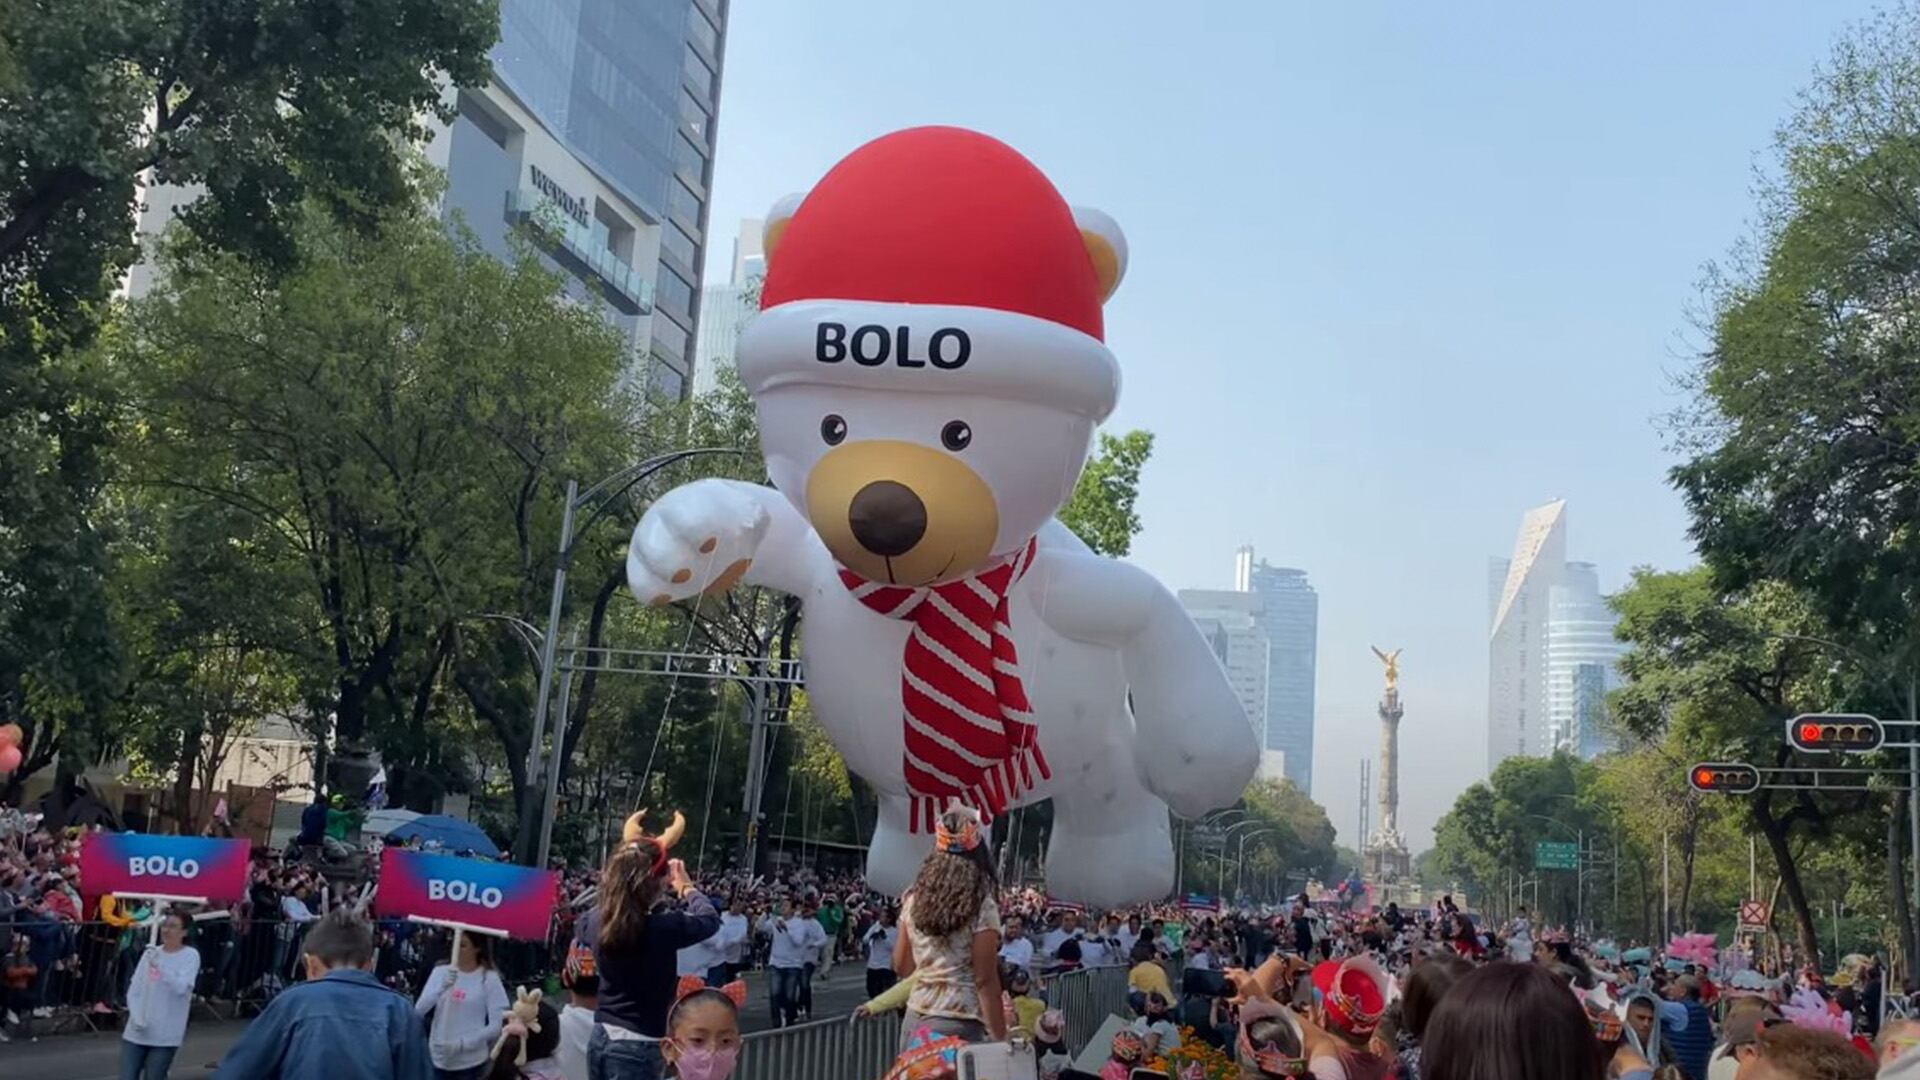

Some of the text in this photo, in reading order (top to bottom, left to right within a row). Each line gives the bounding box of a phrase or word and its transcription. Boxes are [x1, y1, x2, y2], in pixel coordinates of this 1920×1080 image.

[531, 164, 589, 229] wework
[816, 322, 971, 369] BOLO
[128, 855, 200, 879] BOLO
[428, 879, 503, 909] BOLO
